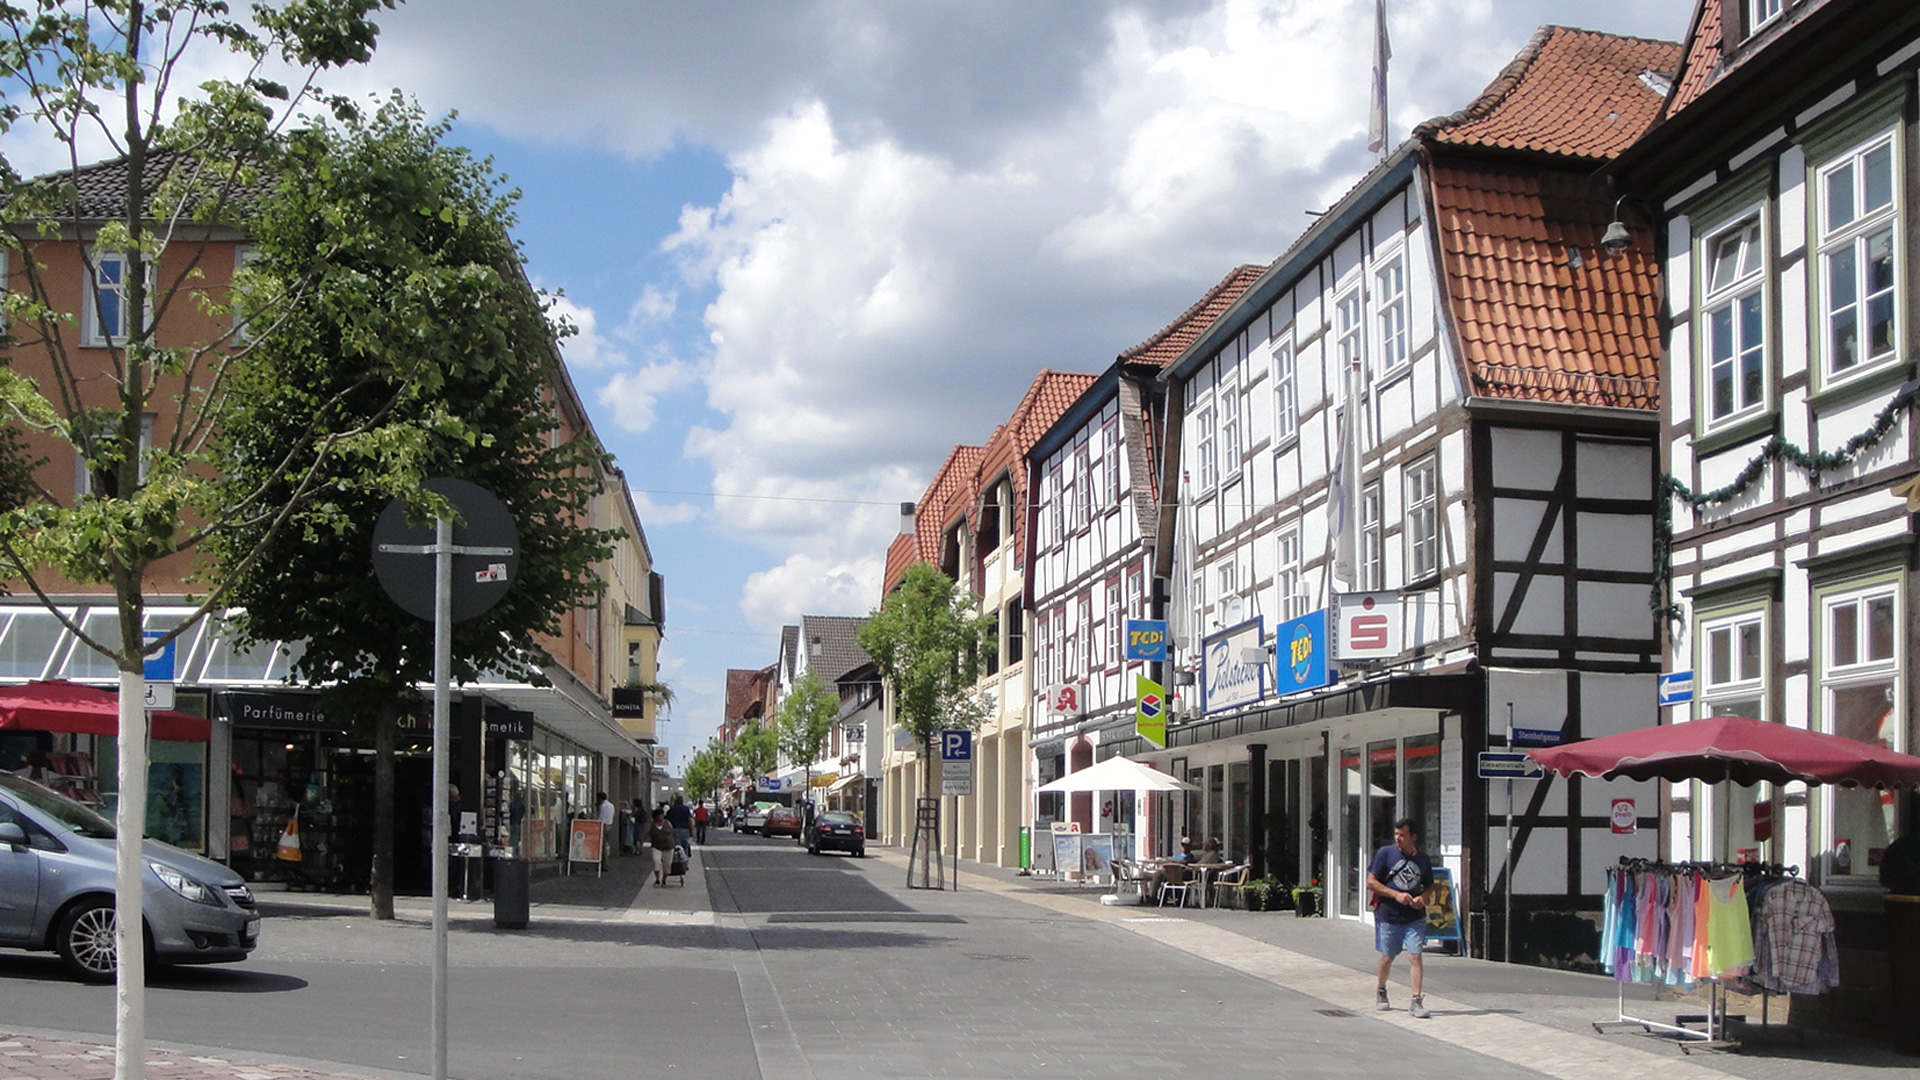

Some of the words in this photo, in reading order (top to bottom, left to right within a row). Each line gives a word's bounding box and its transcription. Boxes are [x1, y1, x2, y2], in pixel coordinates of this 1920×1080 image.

[1342, 661, 1372, 670] Höxter
[243, 704, 325, 722] Parfümerie
[946, 734, 963, 757] P
